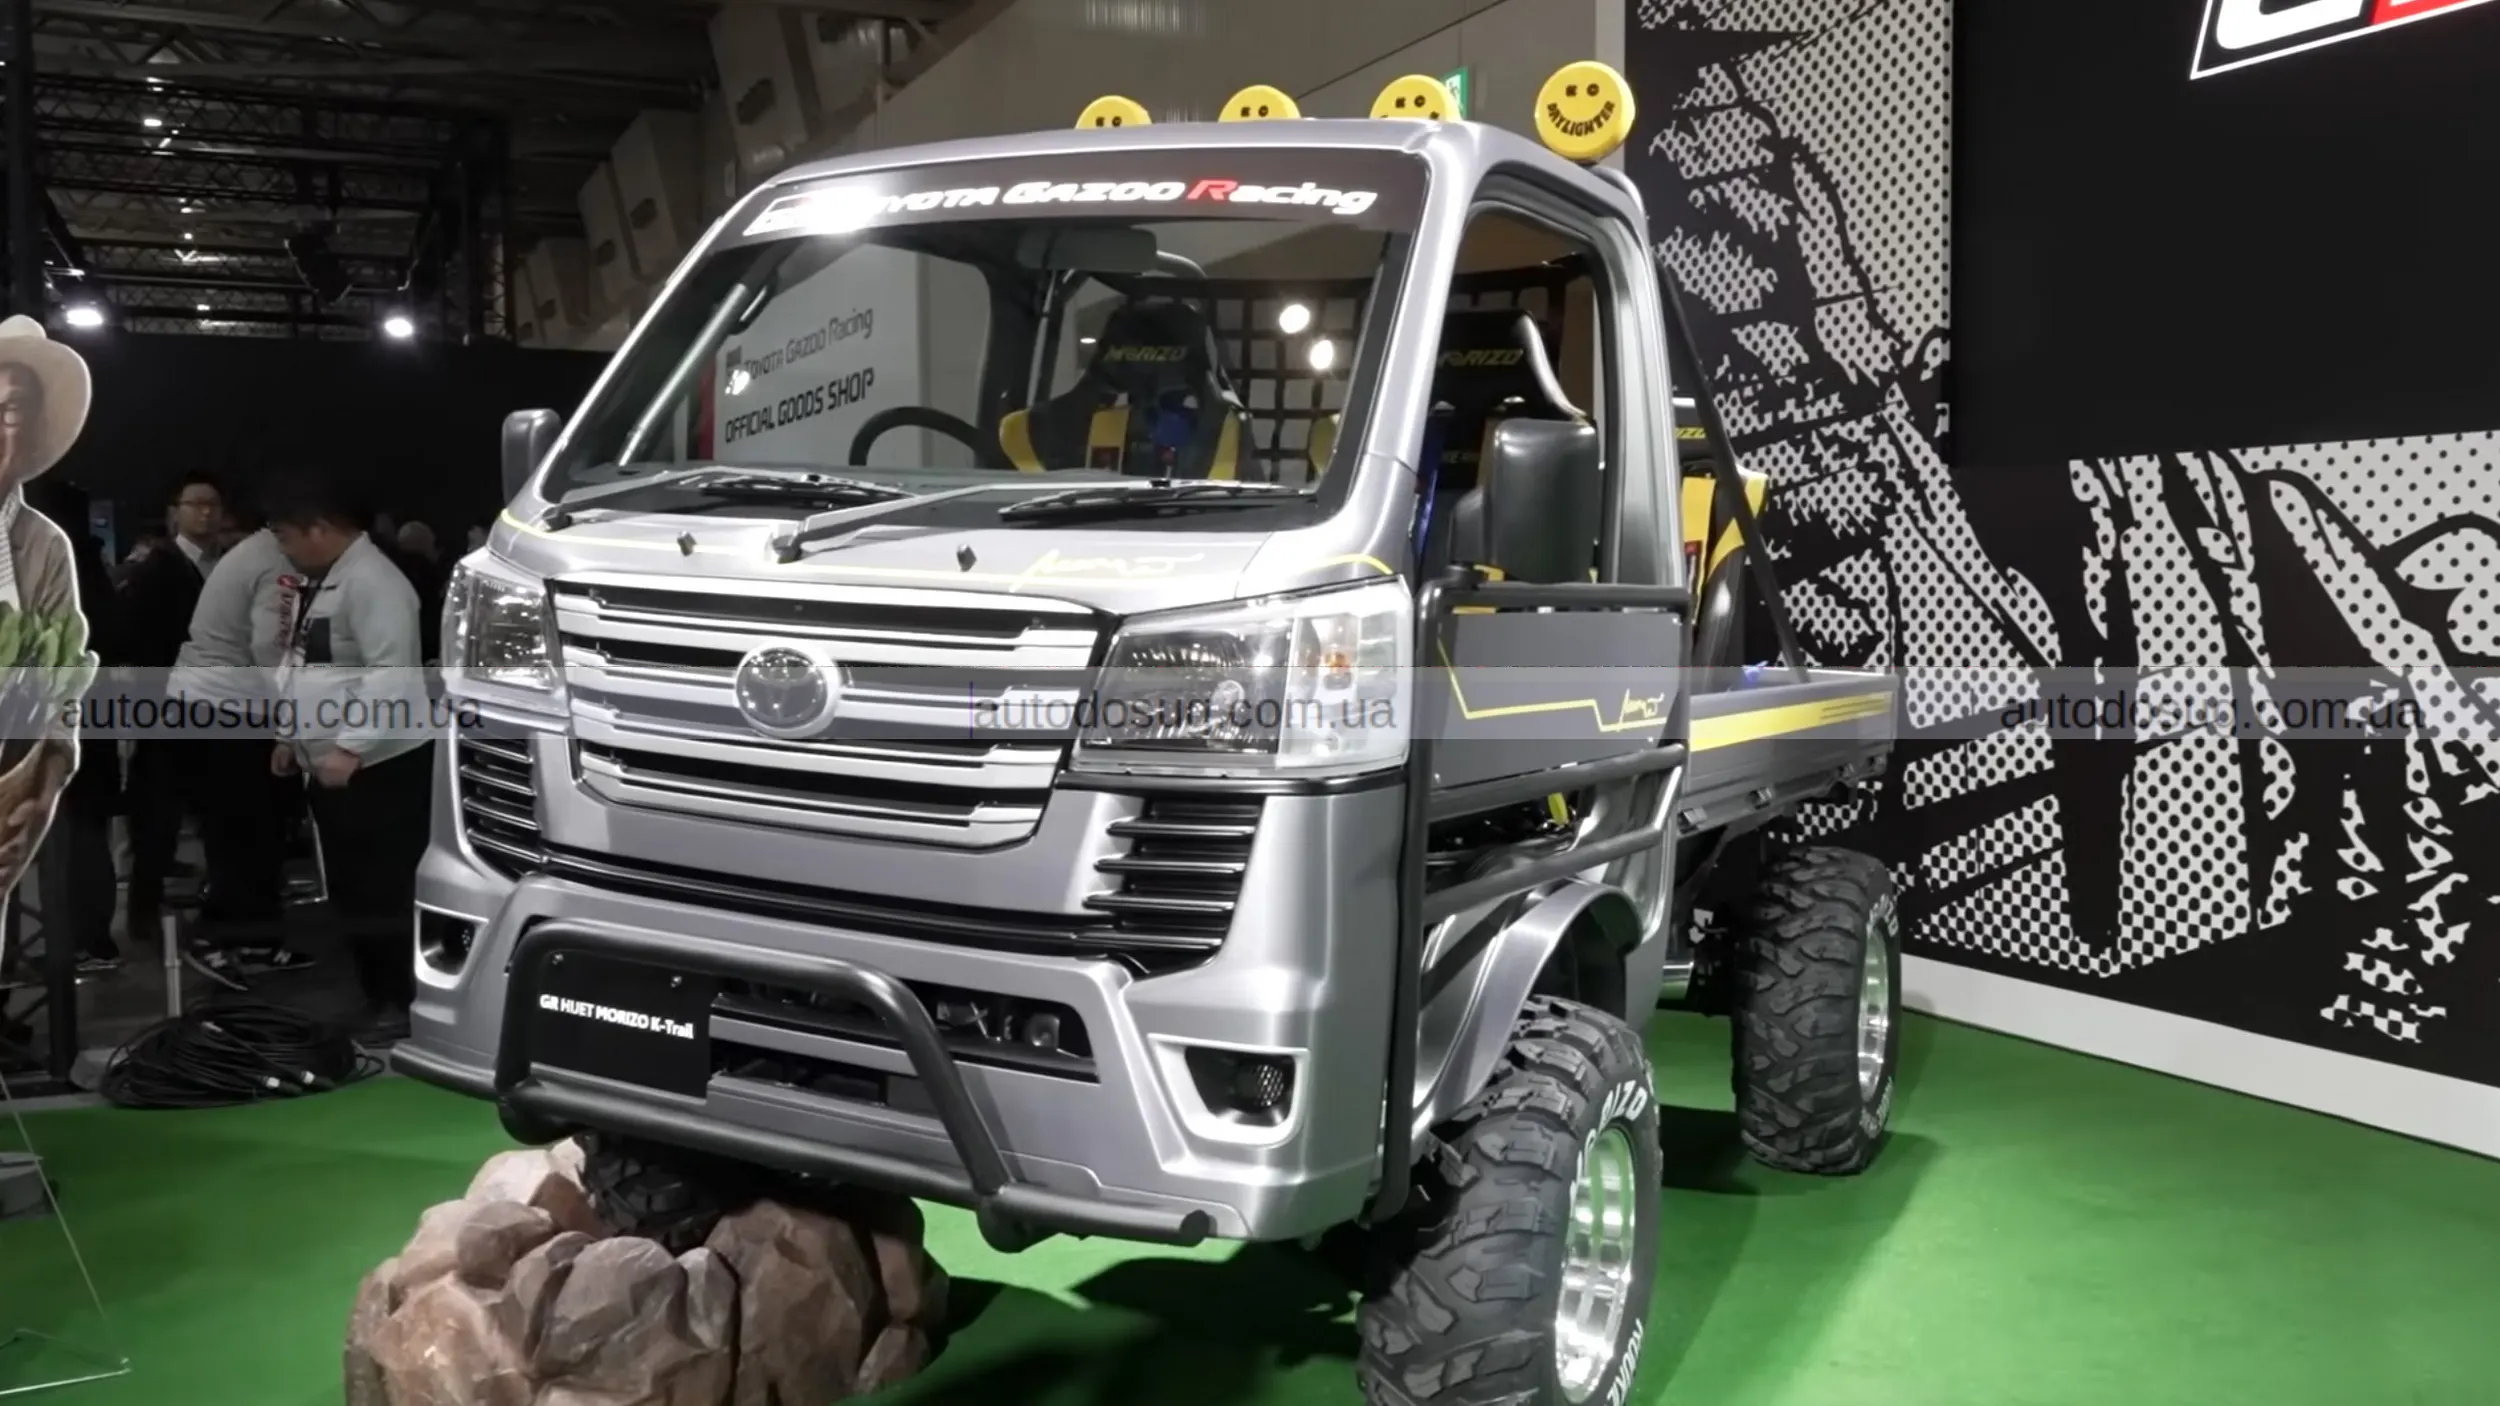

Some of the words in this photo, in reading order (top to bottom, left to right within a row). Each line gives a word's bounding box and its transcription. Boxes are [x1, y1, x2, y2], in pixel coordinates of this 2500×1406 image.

[1547, 100, 1615, 137] DAYLIGHTER
[857, 186, 999, 214] YOTA
[1002, 181, 1185, 205] GAZOO
[1187, 179, 1378, 215] Racing
[786, 327, 826, 365] GAZOO
[828, 307, 873, 347] Racing
[725, 404, 775, 444] OFFICIAL
[778, 385, 824, 426] GOODS
[828, 366, 874, 410] SHOP
[540, 994, 558, 1011] GR
[560, 998, 594, 1018] HUET
[595, 1005, 649, 1029] MORIZO
[651, 1016, 694, 1040] K-Trail
